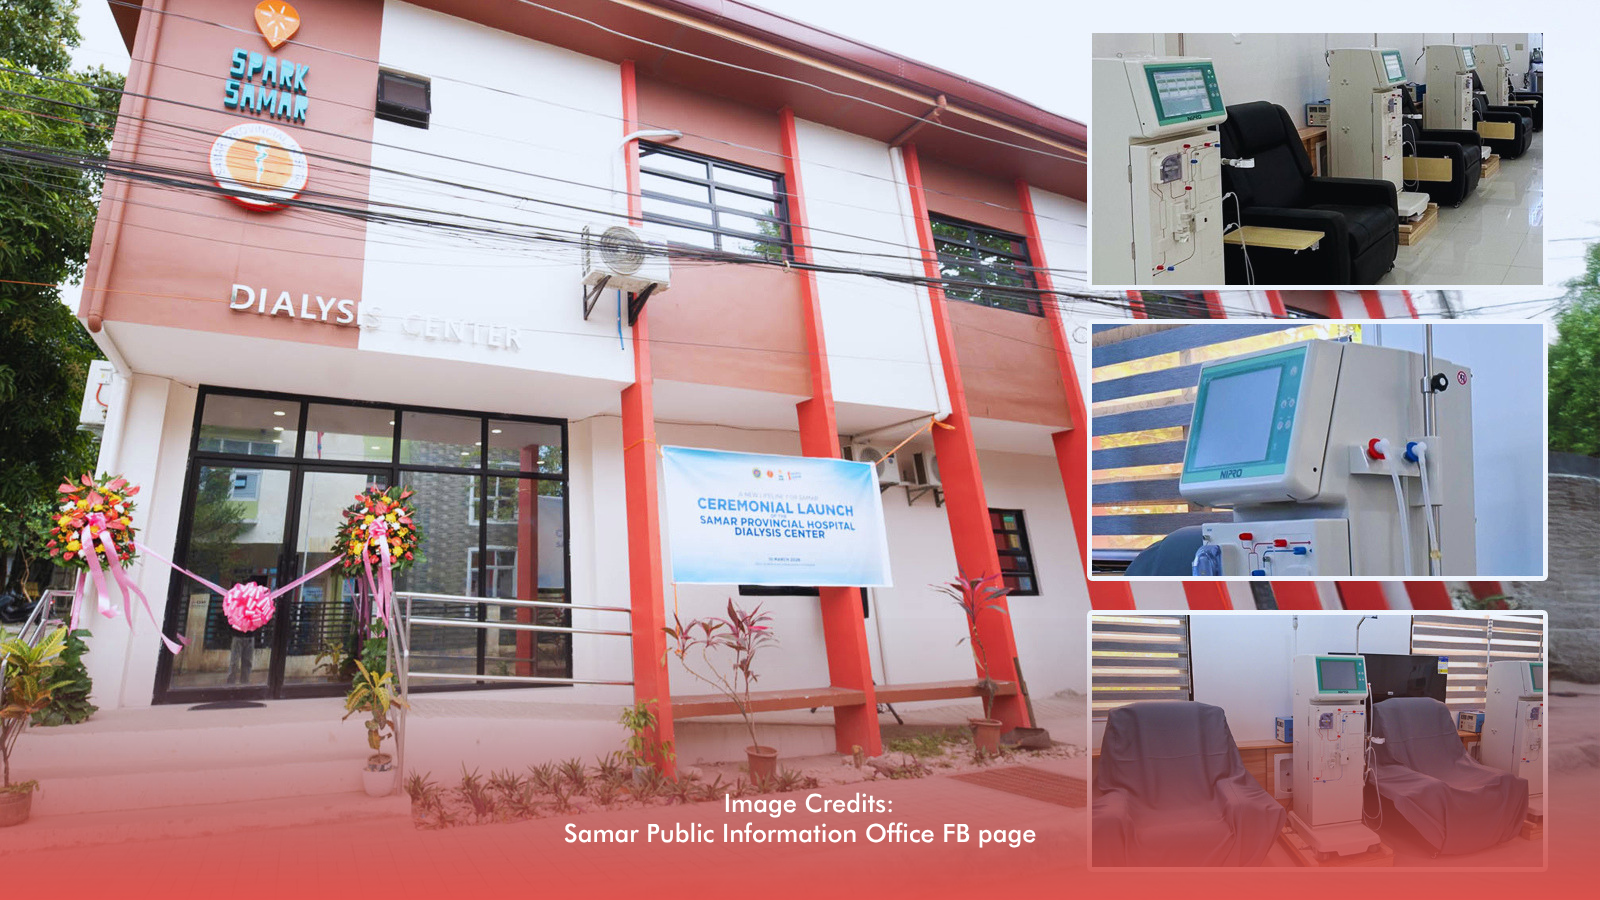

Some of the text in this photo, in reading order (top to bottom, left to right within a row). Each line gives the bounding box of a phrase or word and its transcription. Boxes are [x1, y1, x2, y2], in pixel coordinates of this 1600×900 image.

[230, 47, 310, 95] SPARK
[224, 78, 309, 125] SAMAR
[230, 284, 521, 352] DIALYSIS CENTER
[1220, 469, 1243, 479] NIPRO
[697, 497, 854, 517] CEREMONIAL LAUNCH
[700, 515, 855, 531] SAMAR PROVINCIAL HOSPITAL
[735, 527, 825, 538] DIALYSIS CENTER
